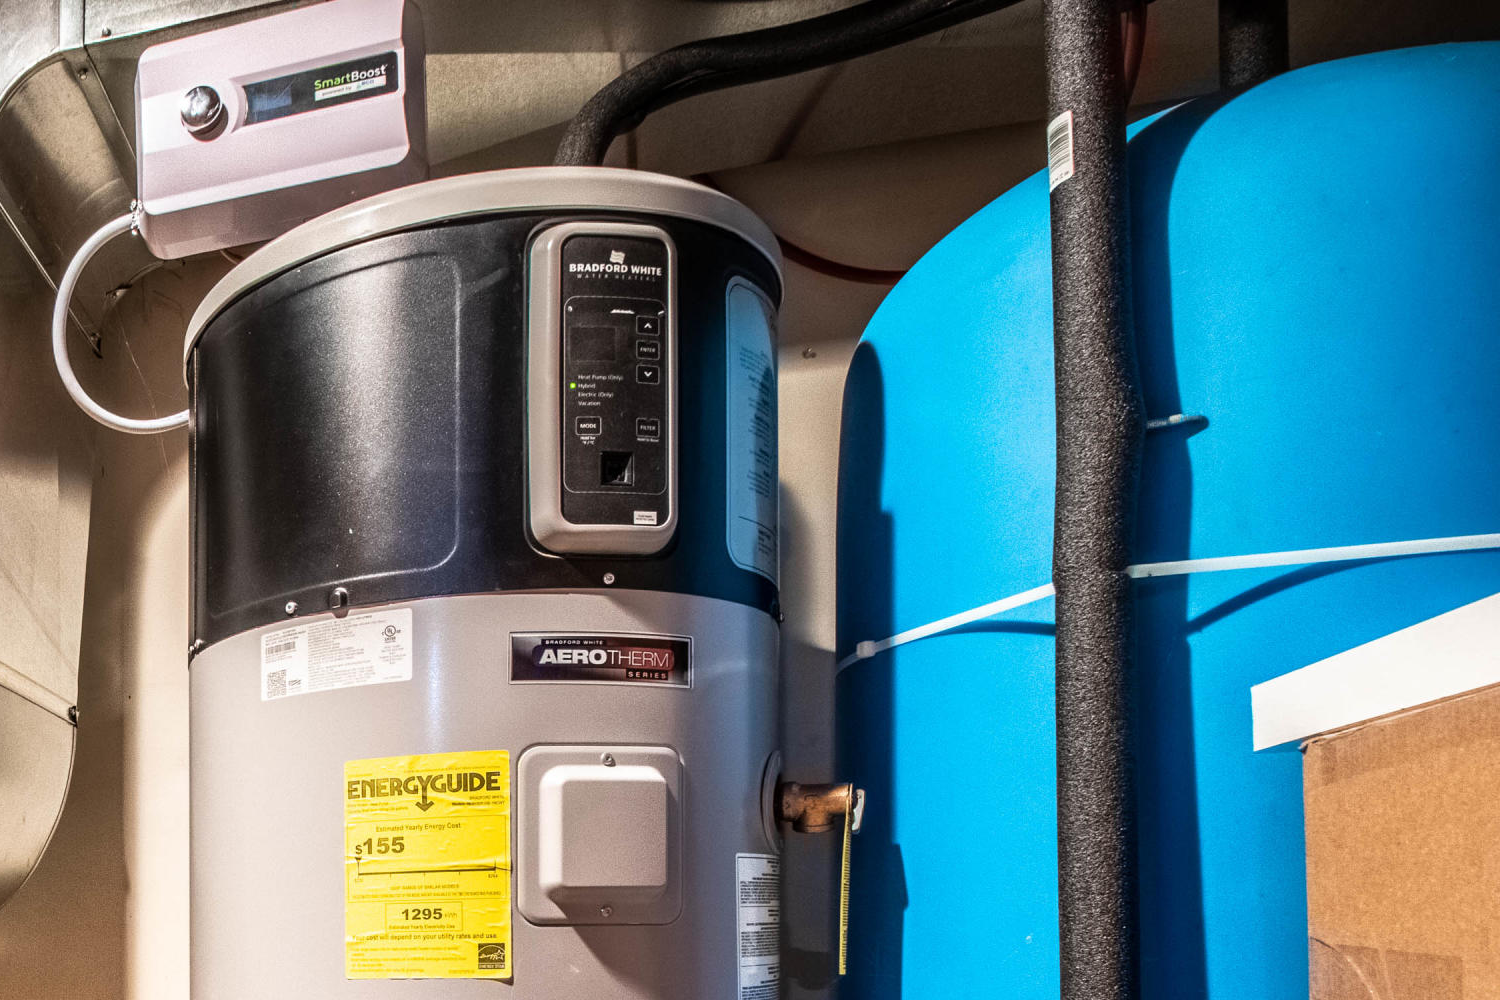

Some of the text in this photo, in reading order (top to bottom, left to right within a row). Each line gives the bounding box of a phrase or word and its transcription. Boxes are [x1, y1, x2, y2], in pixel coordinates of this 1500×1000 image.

[314, 65, 387, 90] SmartBoost
[569, 263, 662, 276] BRADFORD WHITE
[538, 648, 670, 667] AEROTHERM
[627, 671, 667, 679] SERIES
[347, 771, 501, 800] ENERGYGUIDE
[376, 825, 404, 833] Estimated
[405, 824, 423, 832] Yearly
[424, 823, 445, 831] Energy
[355, 836, 405, 855] $155
[401, 908, 443, 921] 1295
[391, 934, 412, 942] depend
